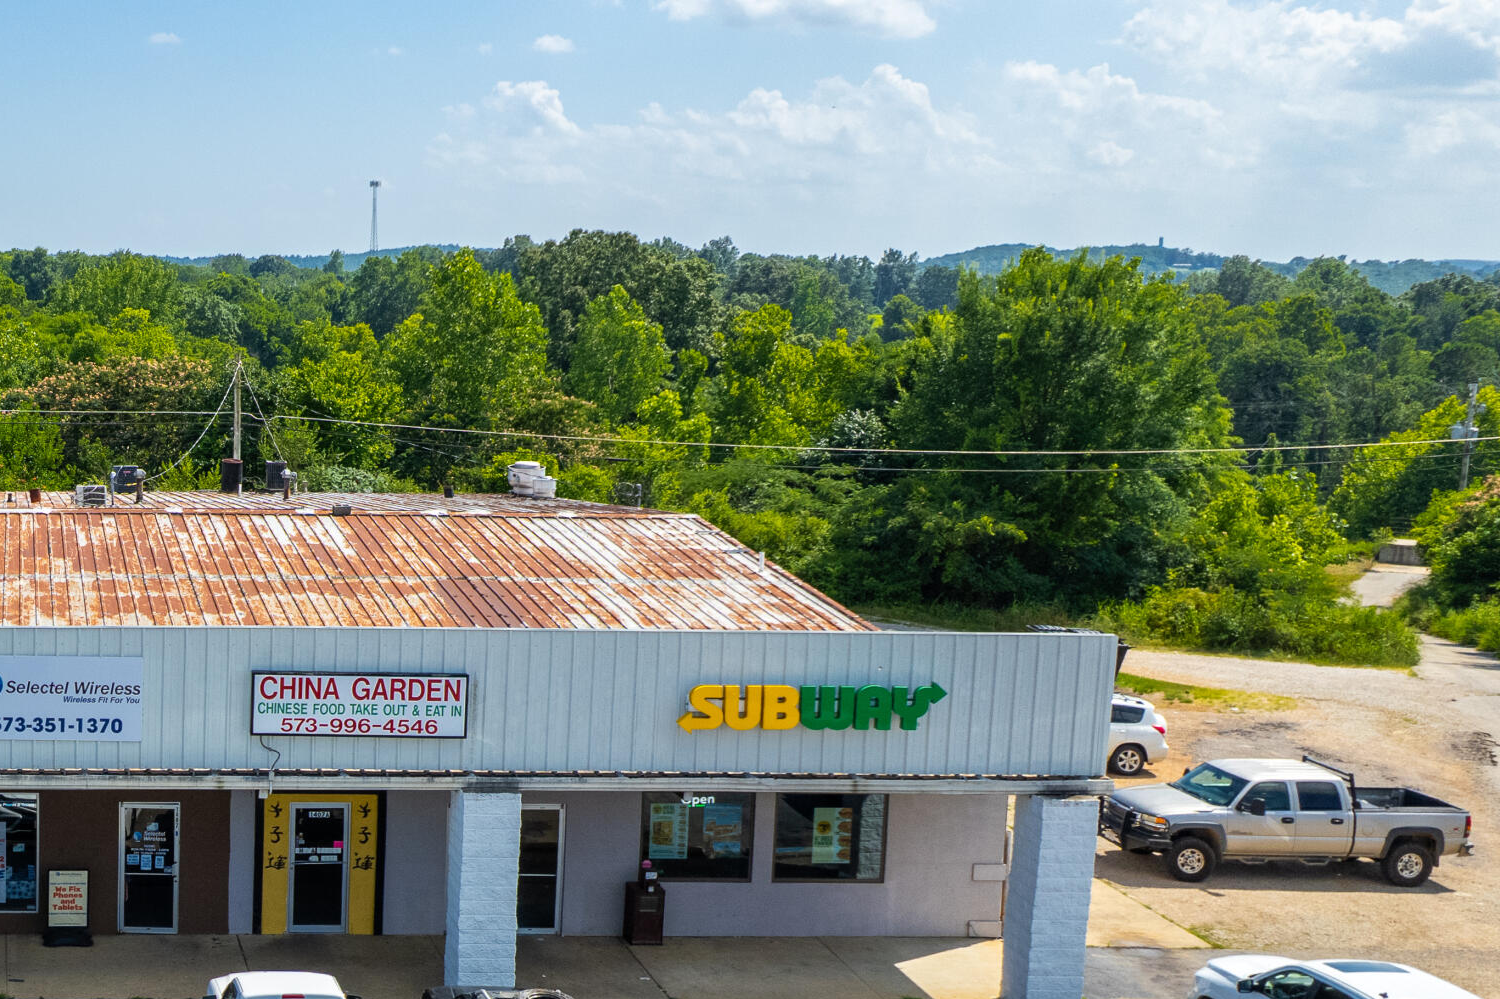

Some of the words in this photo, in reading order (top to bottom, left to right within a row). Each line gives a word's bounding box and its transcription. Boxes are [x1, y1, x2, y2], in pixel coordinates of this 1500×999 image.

[5, 680, 69, 695] Selectel
[74, 681, 141, 696] Wireless
[259, 676, 340, 700] CHINA
[352, 678, 461, 702] GARDEN
[63, 695, 97, 704] Wireless
[98, 696, 108, 704] Fit
[676, 681, 947, 734] SUBWAY
[257, 702, 308, 714] CHINESE
[312, 703, 346, 715] FOOD
[350, 703, 378, 716] TAKE
[383, 704, 408, 716] OUT
[412, 704, 420, 716] &
[425, 705, 446, 717] EAT
[451, 705, 462, 717] IN
[280, 718, 438, 735] 573-996-4546
